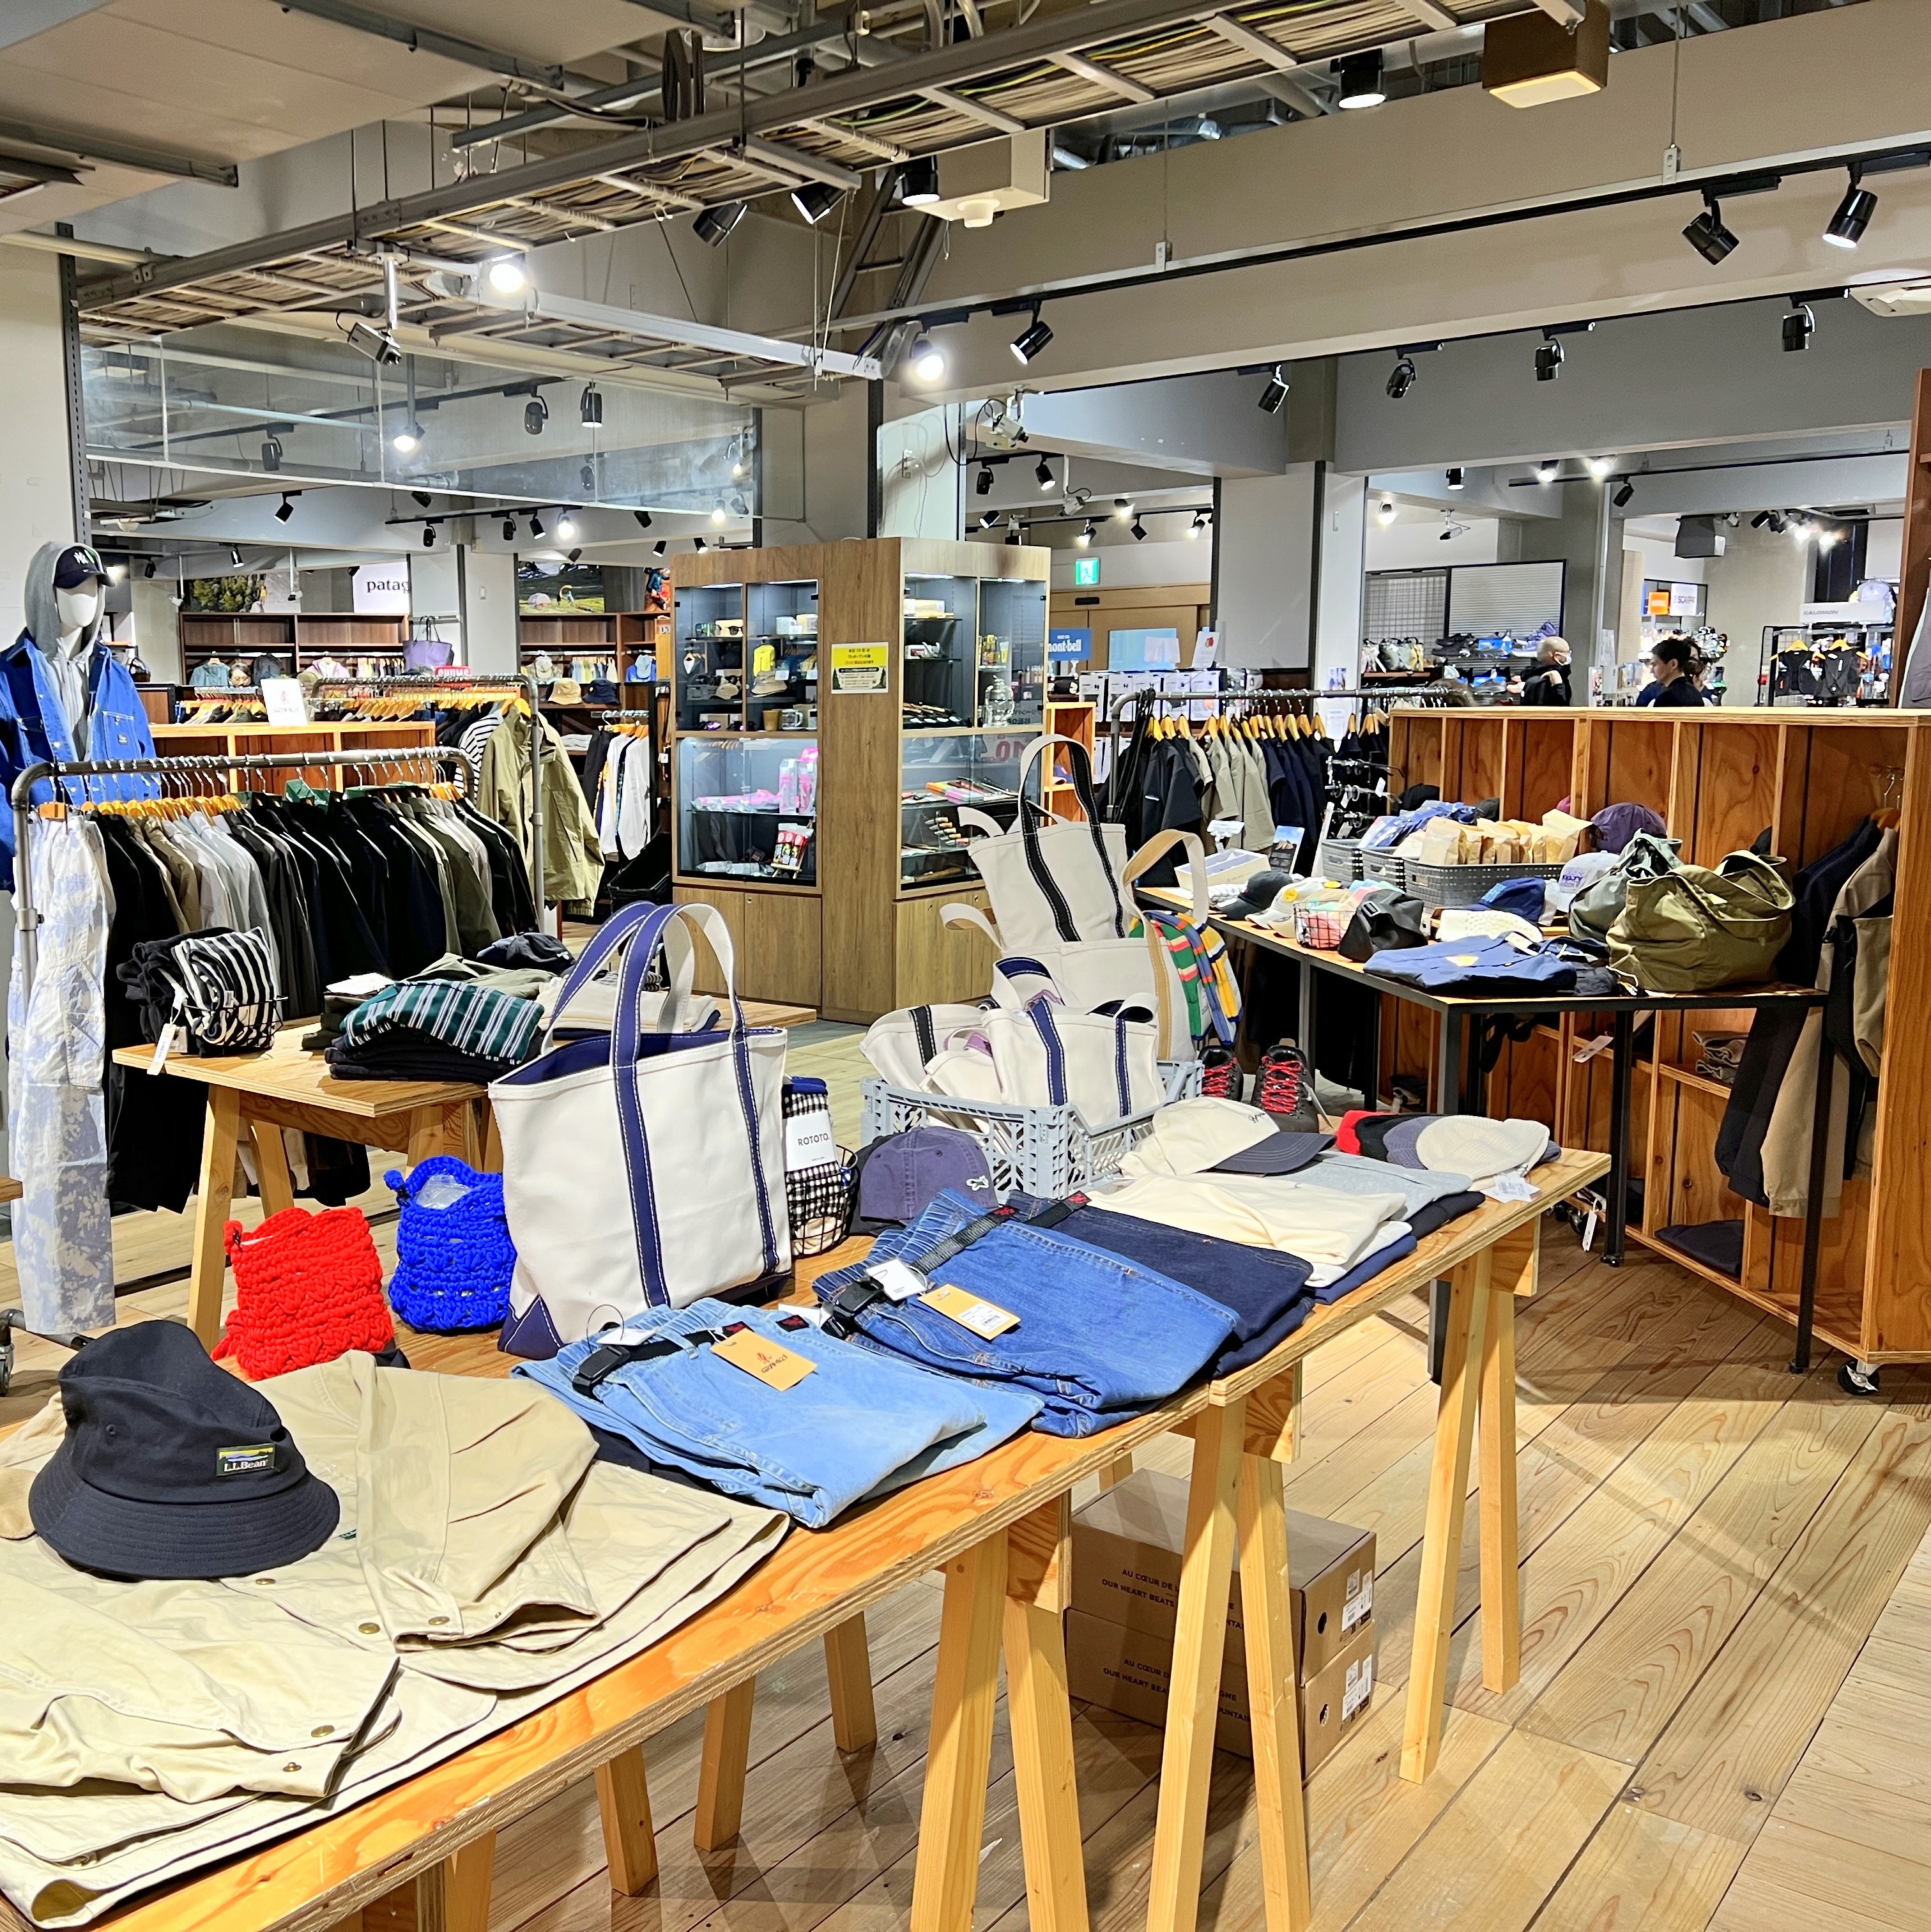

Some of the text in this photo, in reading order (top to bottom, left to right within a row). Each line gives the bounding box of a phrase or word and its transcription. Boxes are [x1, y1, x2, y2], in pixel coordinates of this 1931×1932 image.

[797, 1133, 828, 1146] ROTOTO
[1122, 1568, 1133, 1577] AU
[1161, 1581, 1173, 1590] DE
[1102, 1579, 1118, 1589] OUR
[1120, 1584, 1147, 1598] HEART
[1150, 1594, 1175, 1607] BEATS
[1124, 1659, 1134, 1667] AU
[1103, 1667, 1120, 1678] OUR
[1122, 1674, 1149, 1688] HEART
